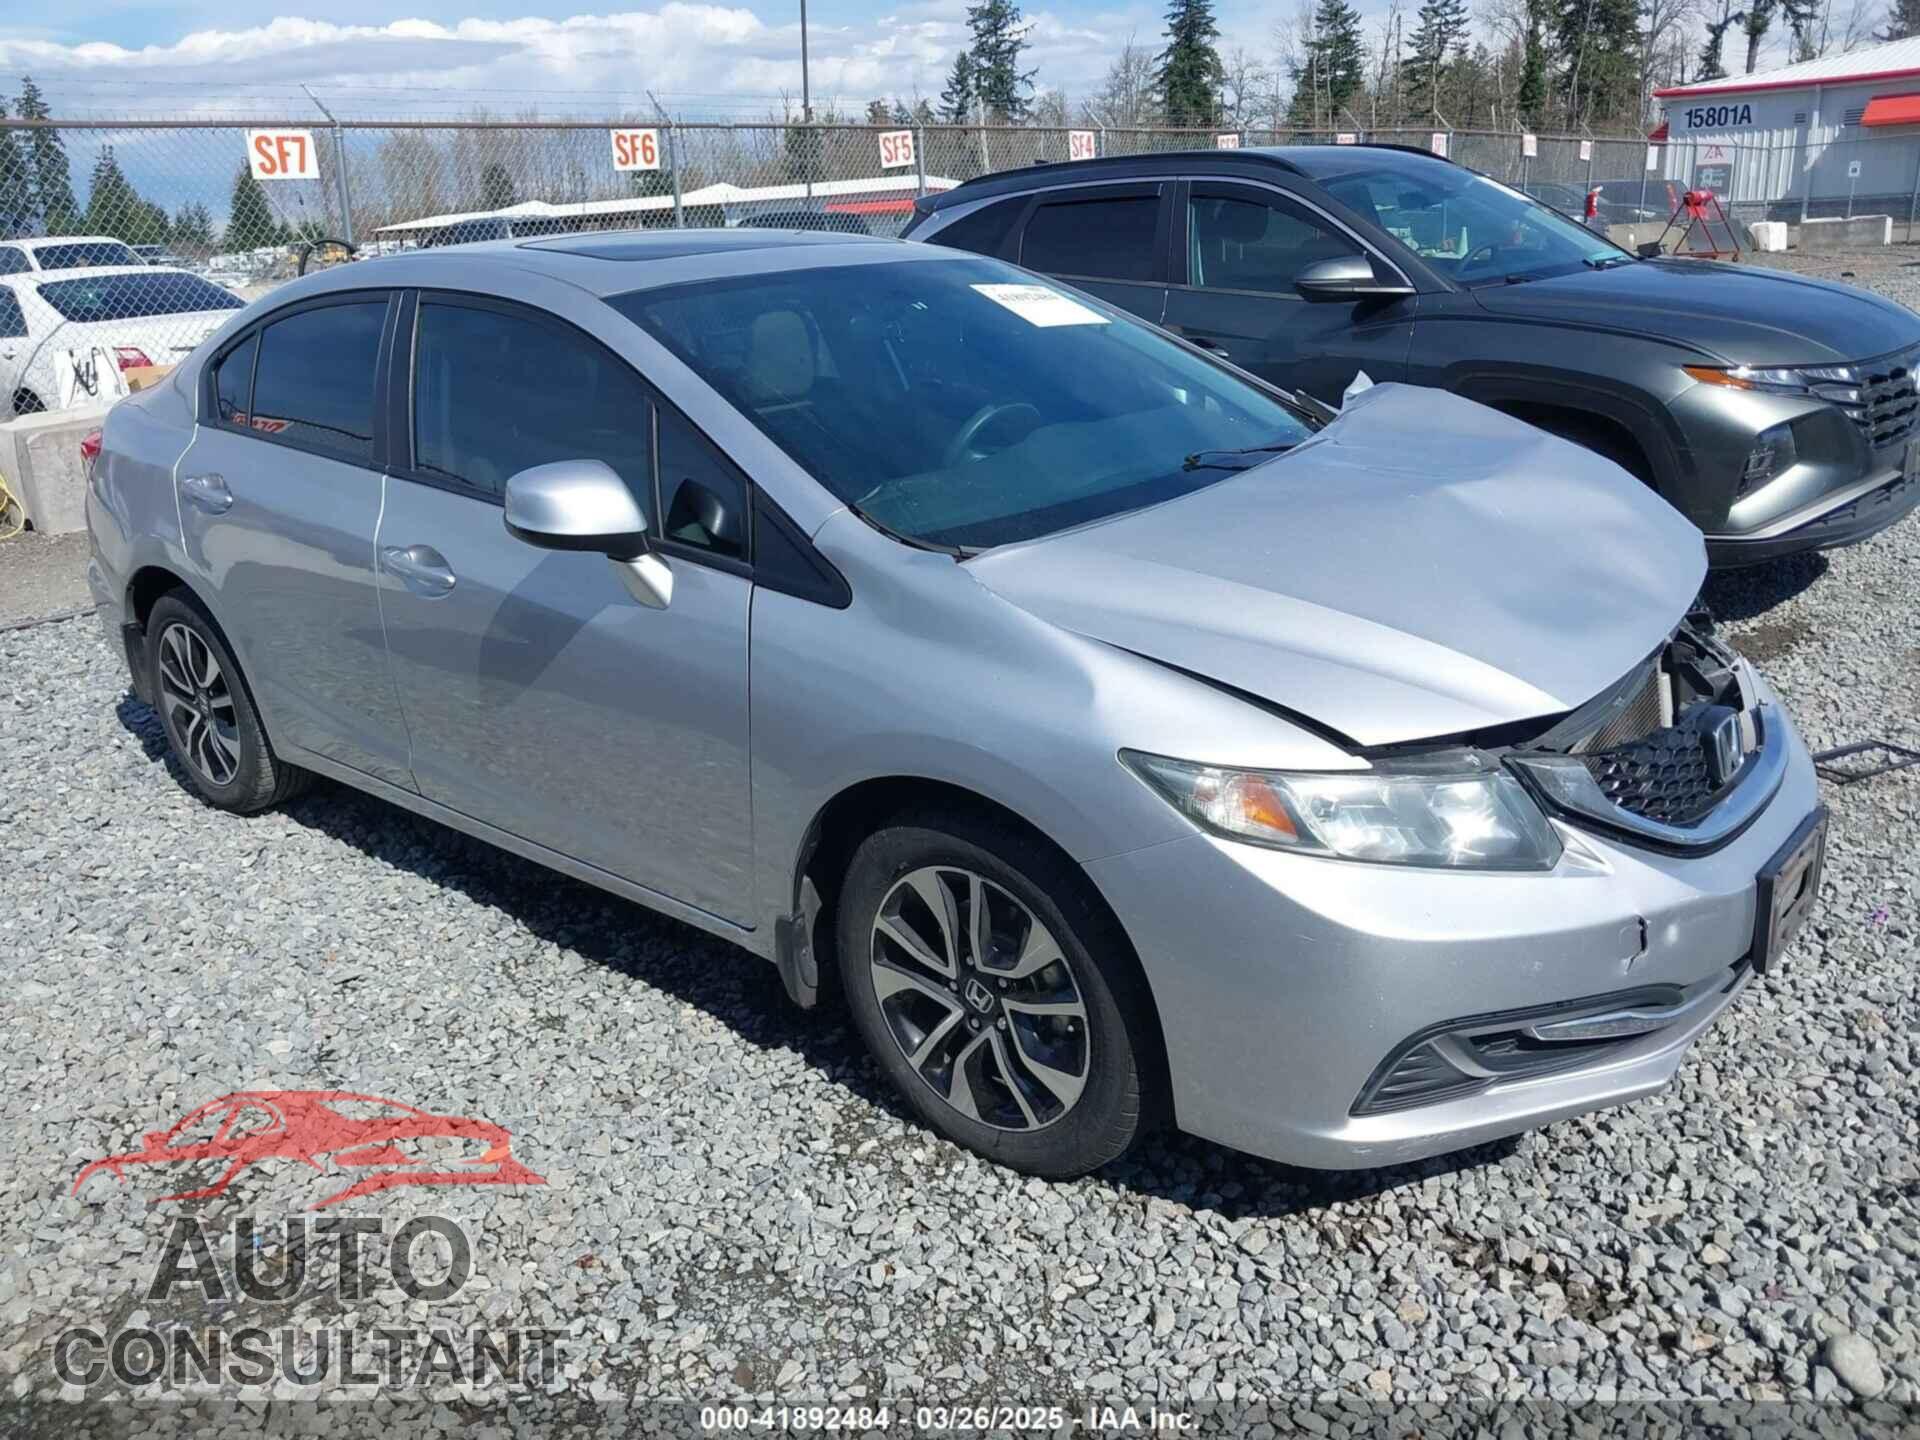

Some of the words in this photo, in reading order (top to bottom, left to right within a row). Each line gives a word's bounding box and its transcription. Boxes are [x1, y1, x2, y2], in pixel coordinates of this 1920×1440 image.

[1684, 104, 1752, 128] 15801A
[255, 135, 305, 174] SF7
[615, 133, 655, 165] SF6
[882, 135, 911, 162] SF5
[1072, 134, 1092, 157] SF4
